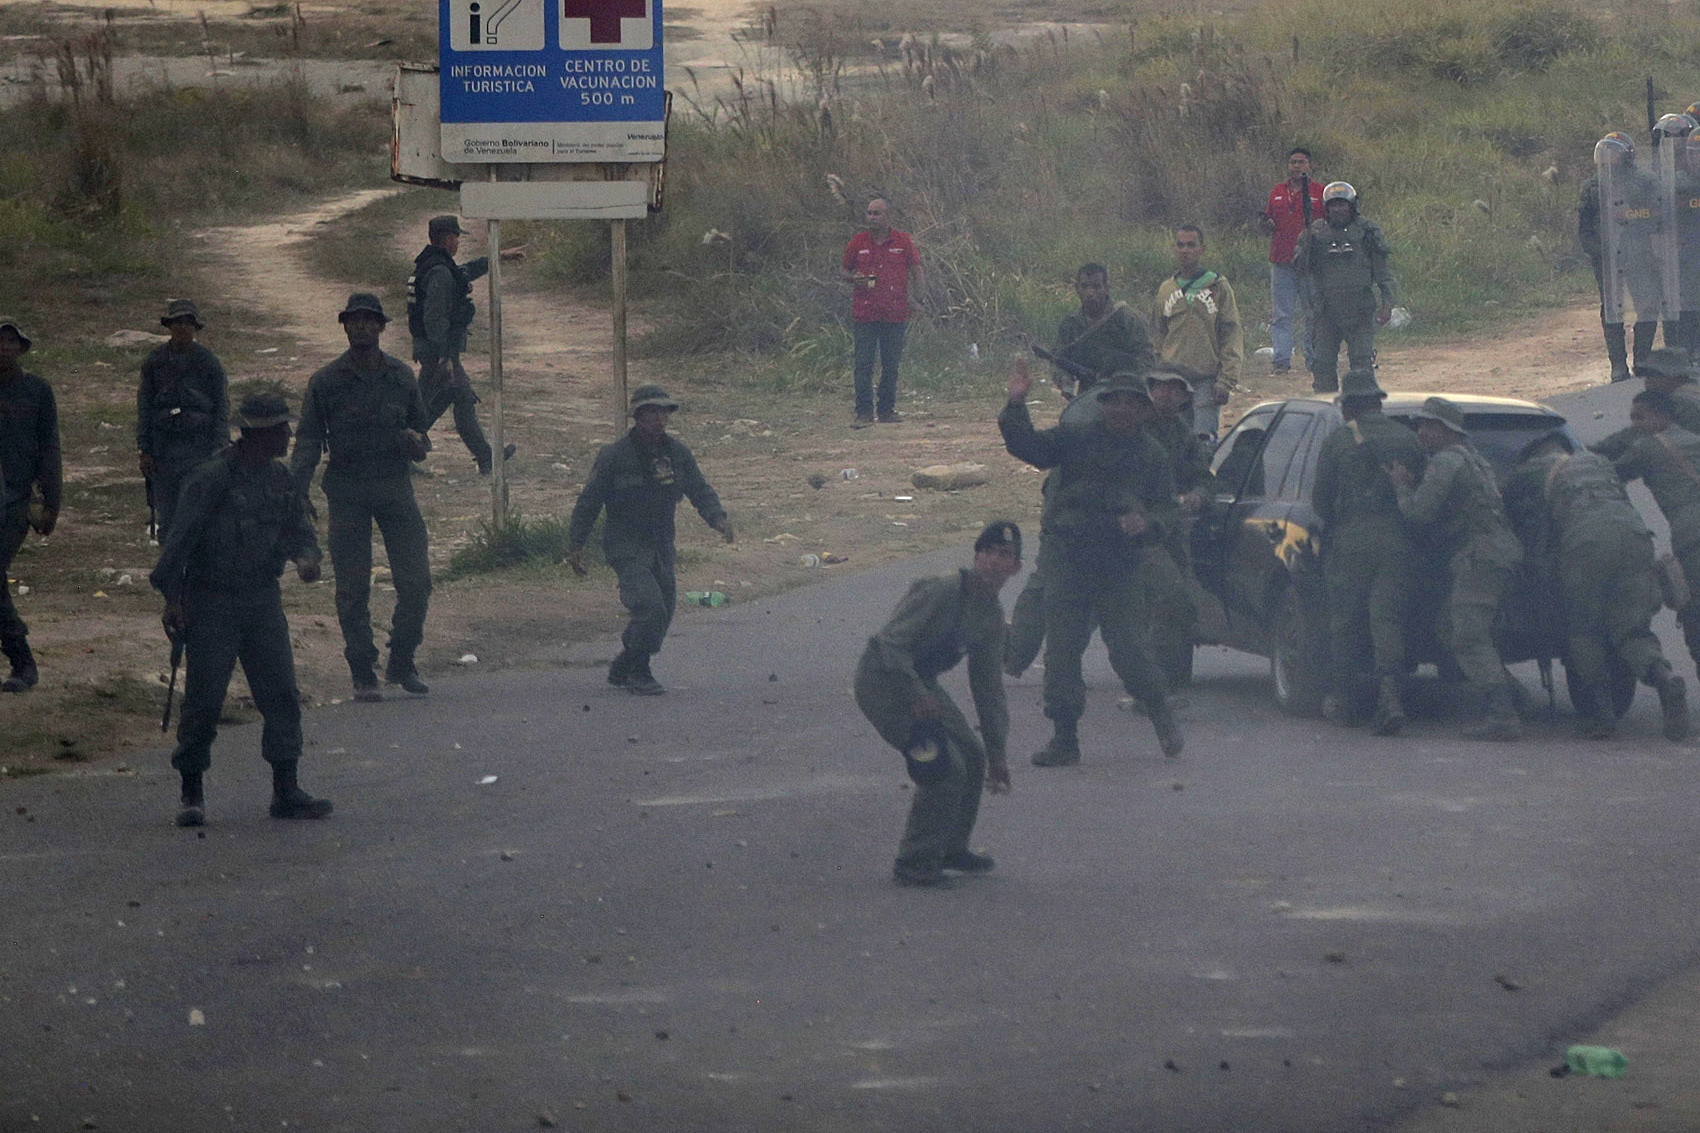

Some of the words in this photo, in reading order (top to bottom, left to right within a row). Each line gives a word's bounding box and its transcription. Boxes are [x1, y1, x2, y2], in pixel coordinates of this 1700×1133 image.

[451, 65, 546, 77] INFORMACION
[565, 60, 625, 72] CENTRO
[631, 60, 650, 72] DE
[464, 81, 534, 92] TURISTICA
[560, 76, 656, 88] VACUNACION
[581, 93, 613, 105] 500
[621, 96, 635, 104] m
[464, 139, 500, 147] Gobierno
[502, 139, 549, 147] Bolivariano
[476, 147, 517, 155] Venezuela
[1625, 209, 1651, 218] GNB
